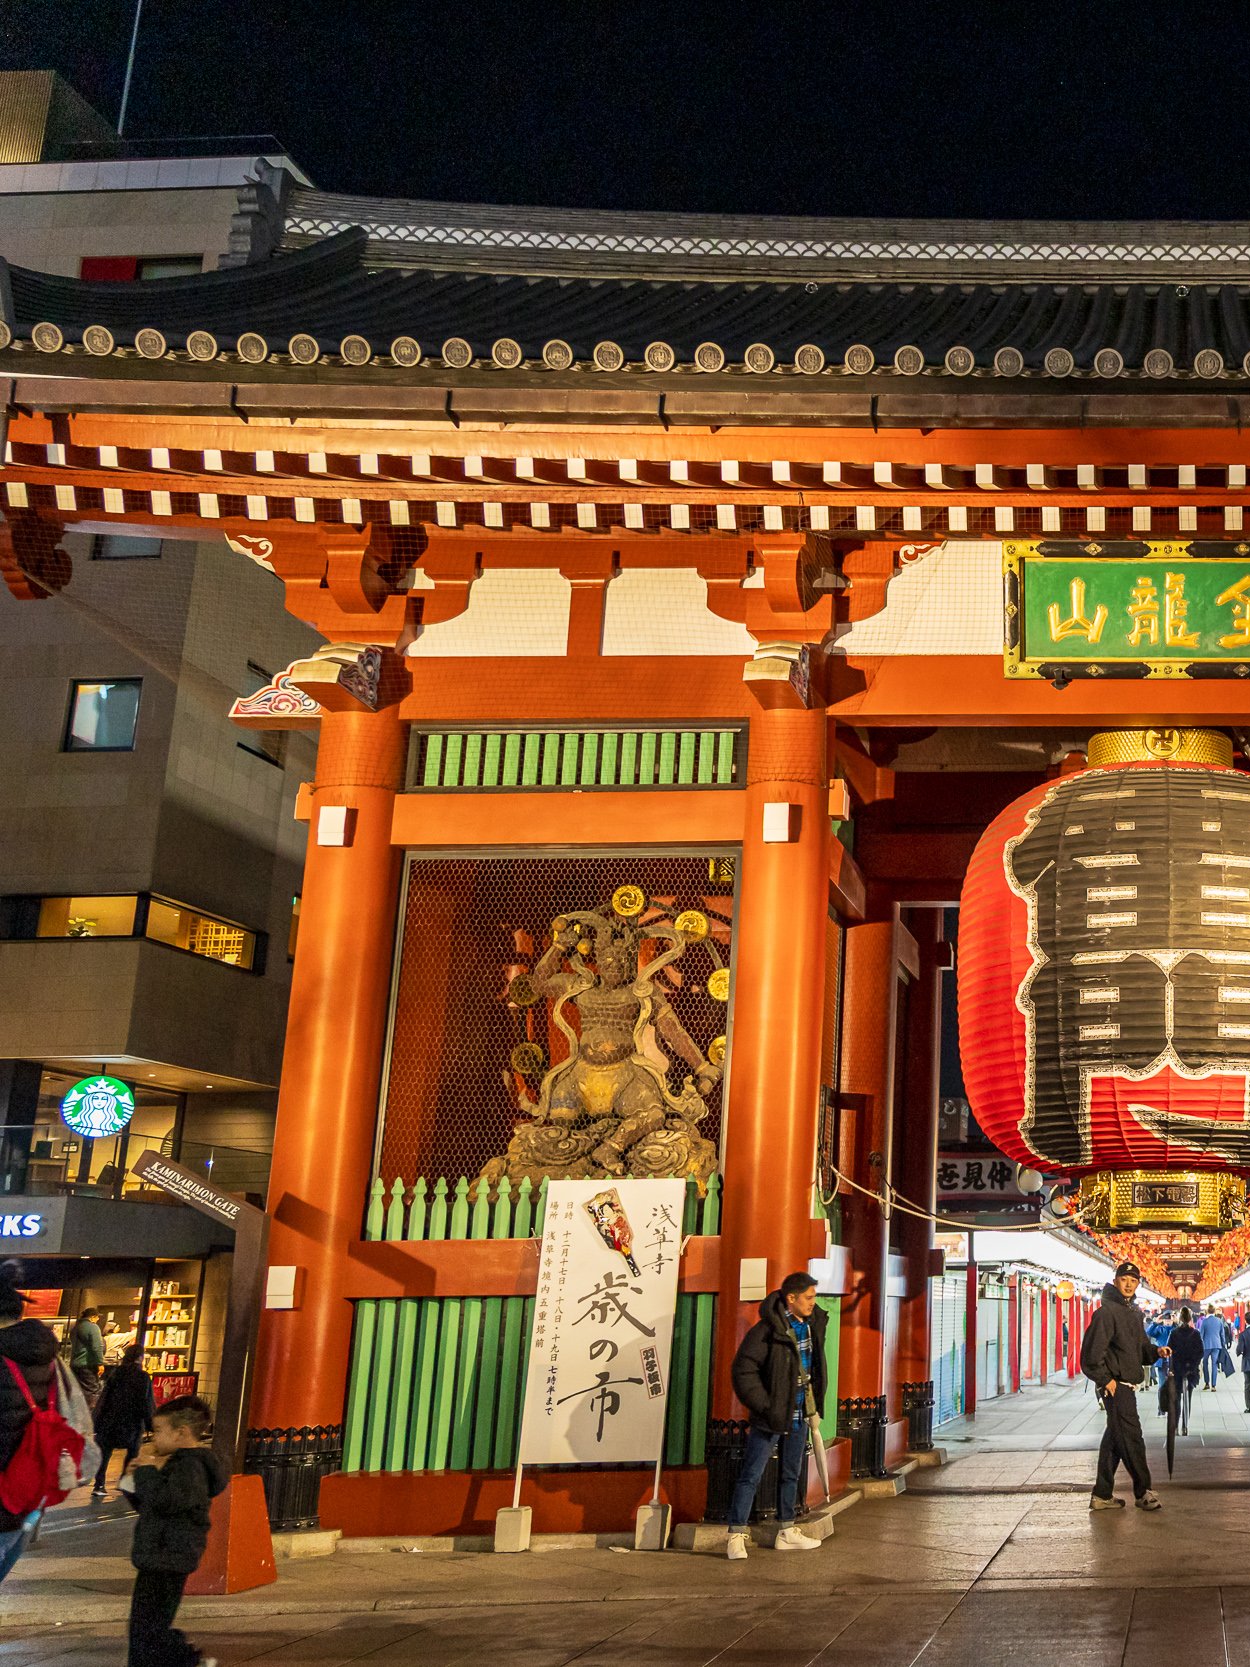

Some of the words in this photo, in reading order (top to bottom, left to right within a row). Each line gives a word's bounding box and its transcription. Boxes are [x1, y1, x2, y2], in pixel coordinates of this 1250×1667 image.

[151, 1161, 217, 1202] KAMINARIMON
[214, 1197, 241, 1216] GATE
[564, 1201, 574, 1220] 日時
[0, 1214, 41, 1236] KS
[642, 1204, 678, 1275] 浅草寺
[557, 1271, 656, 1443] 歳の市
